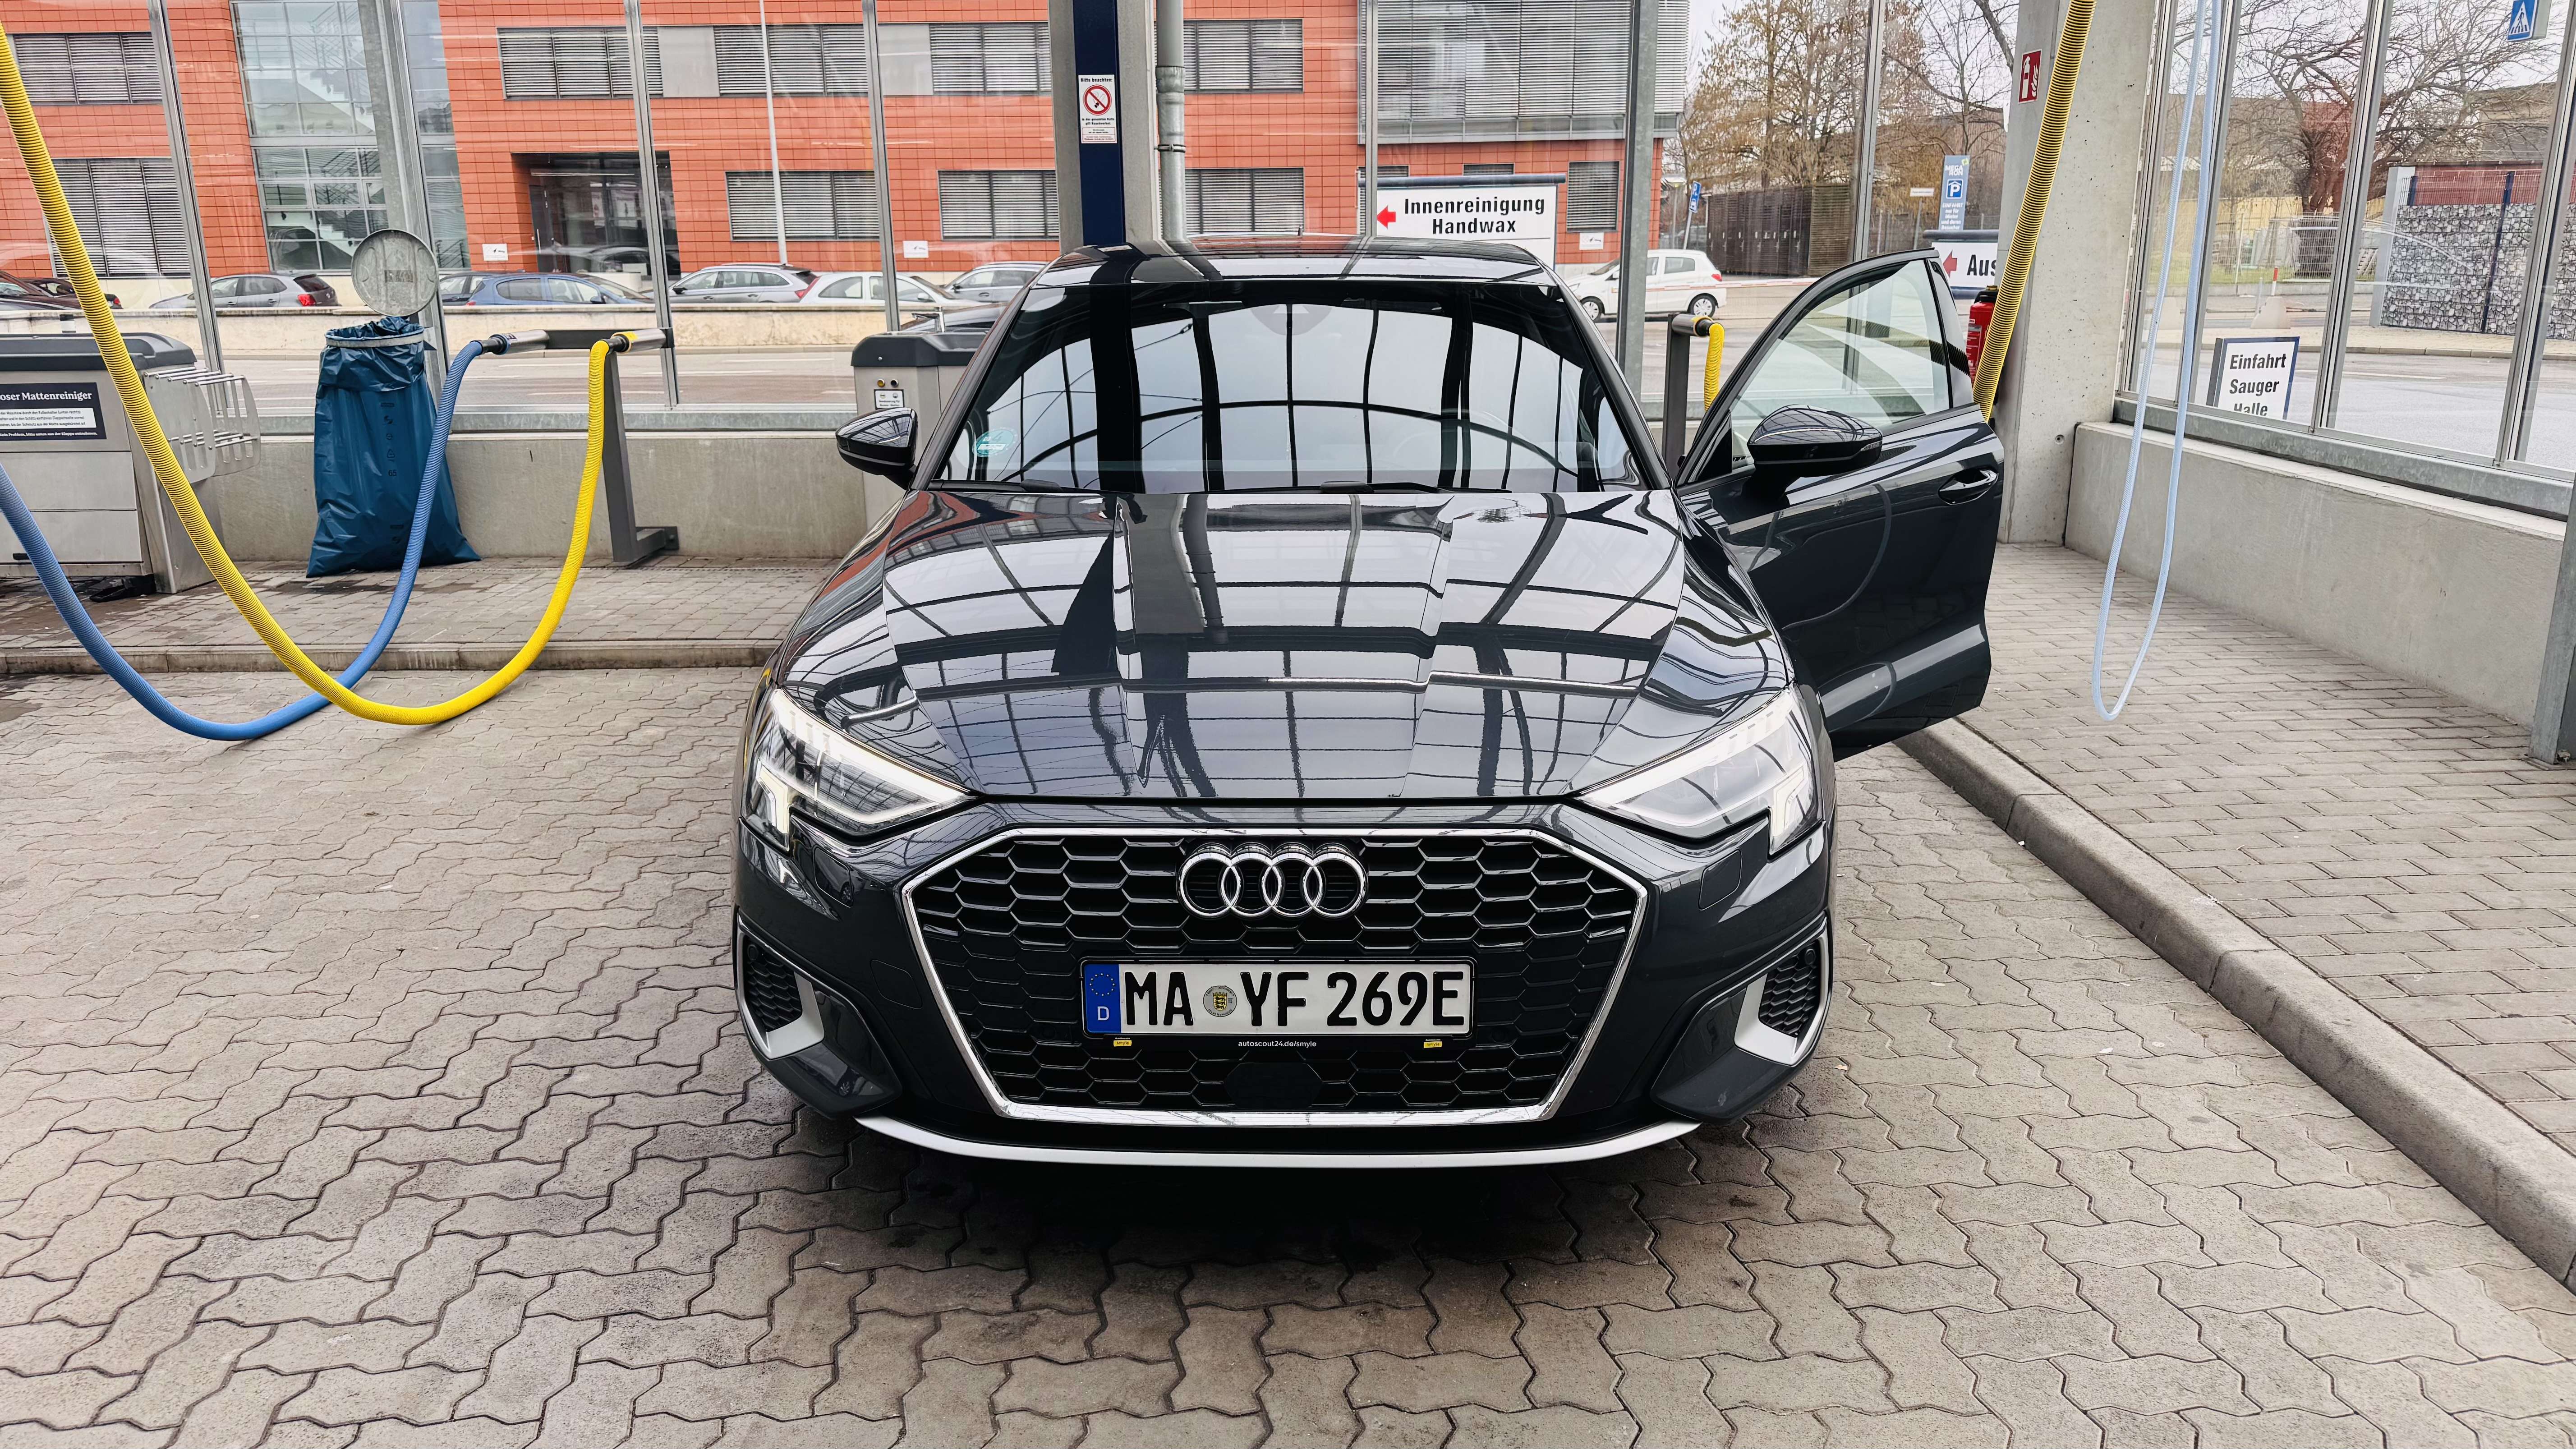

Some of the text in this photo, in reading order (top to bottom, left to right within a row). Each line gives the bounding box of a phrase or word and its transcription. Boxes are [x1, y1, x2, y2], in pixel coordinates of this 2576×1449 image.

[1950, 184, 1960, 197] P
[1404, 197, 1545, 216] Innenreinigung
[1432, 218, 1516, 235] Handwax
[2230, 354, 2286, 369] Einfahrt
[2229, 379, 2280, 396] Sauger
[22, 391, 92, 401] Mattenreiniger
[1125, 971, 1464, 1026] MA YF 269E
[1097, 1006, 1109, 1021] D
